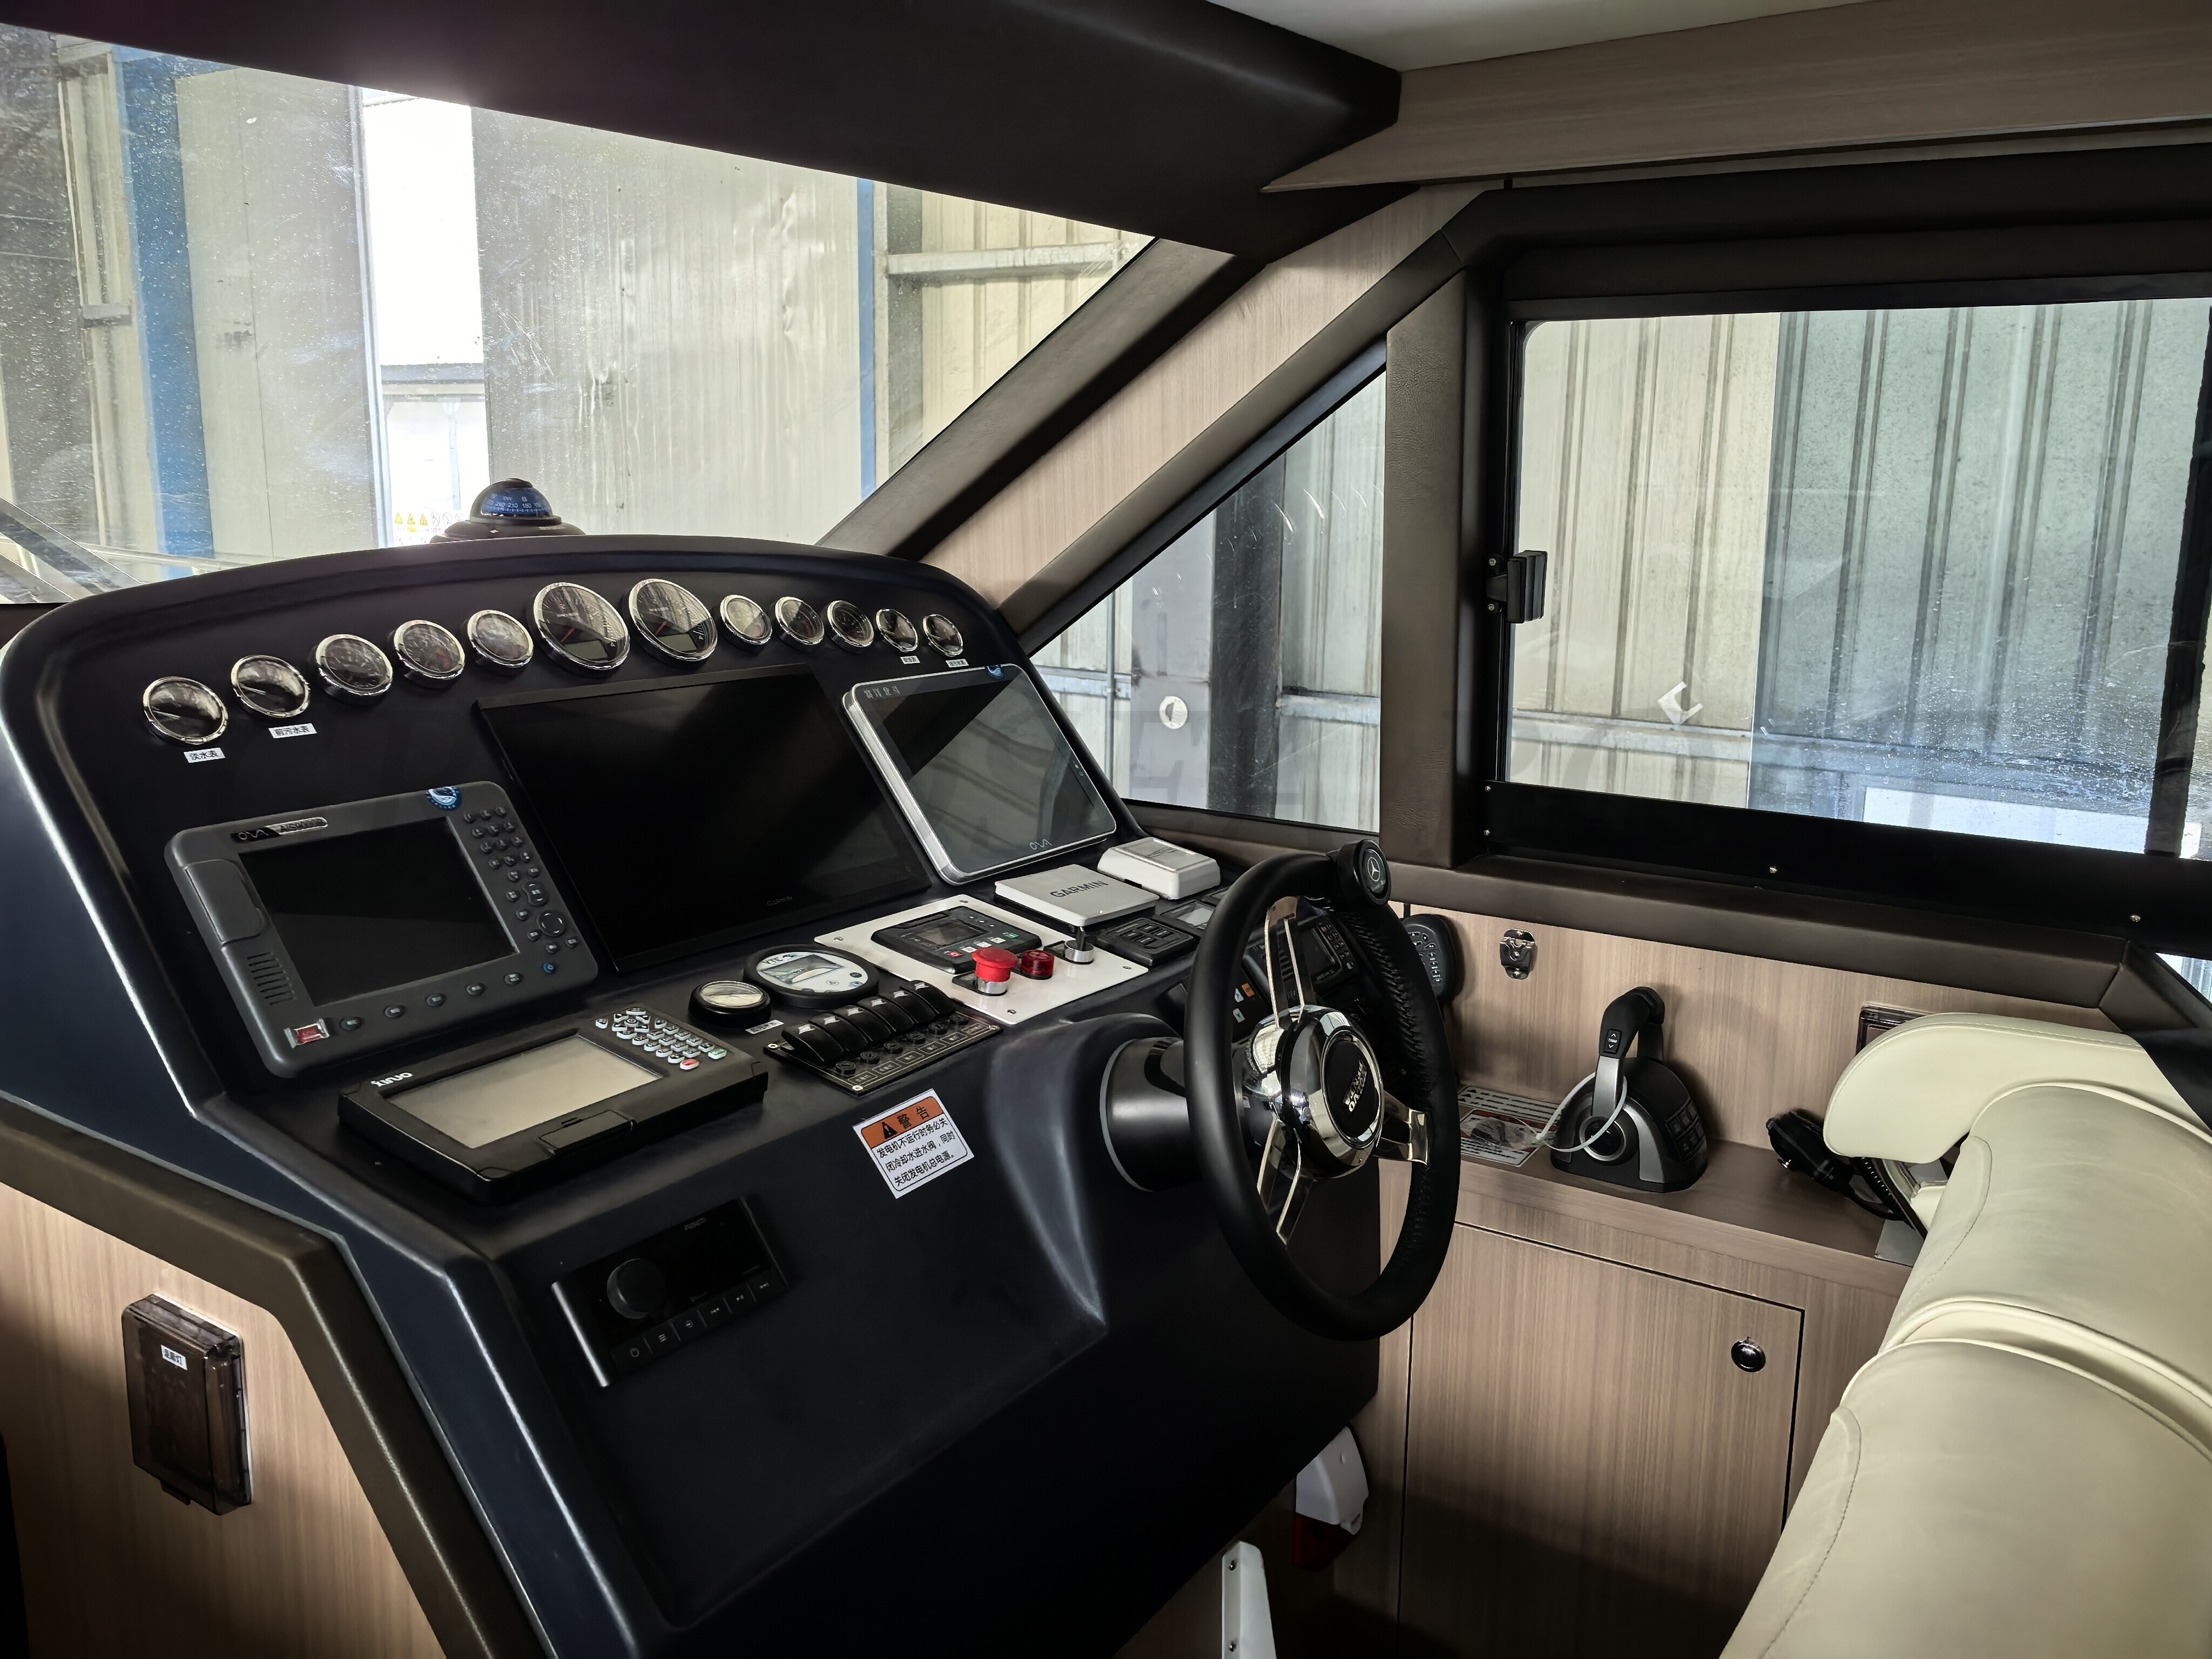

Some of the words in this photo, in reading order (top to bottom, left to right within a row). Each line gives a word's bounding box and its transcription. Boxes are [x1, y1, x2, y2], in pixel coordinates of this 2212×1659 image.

[190, 750, 219, 760] 淡水表
[1050, 880, 1109, 898] GARMIN
[897, 1105, 930, 1129] 警告
[876, 1117, 948, 1158] 发电机不运行时务必关
